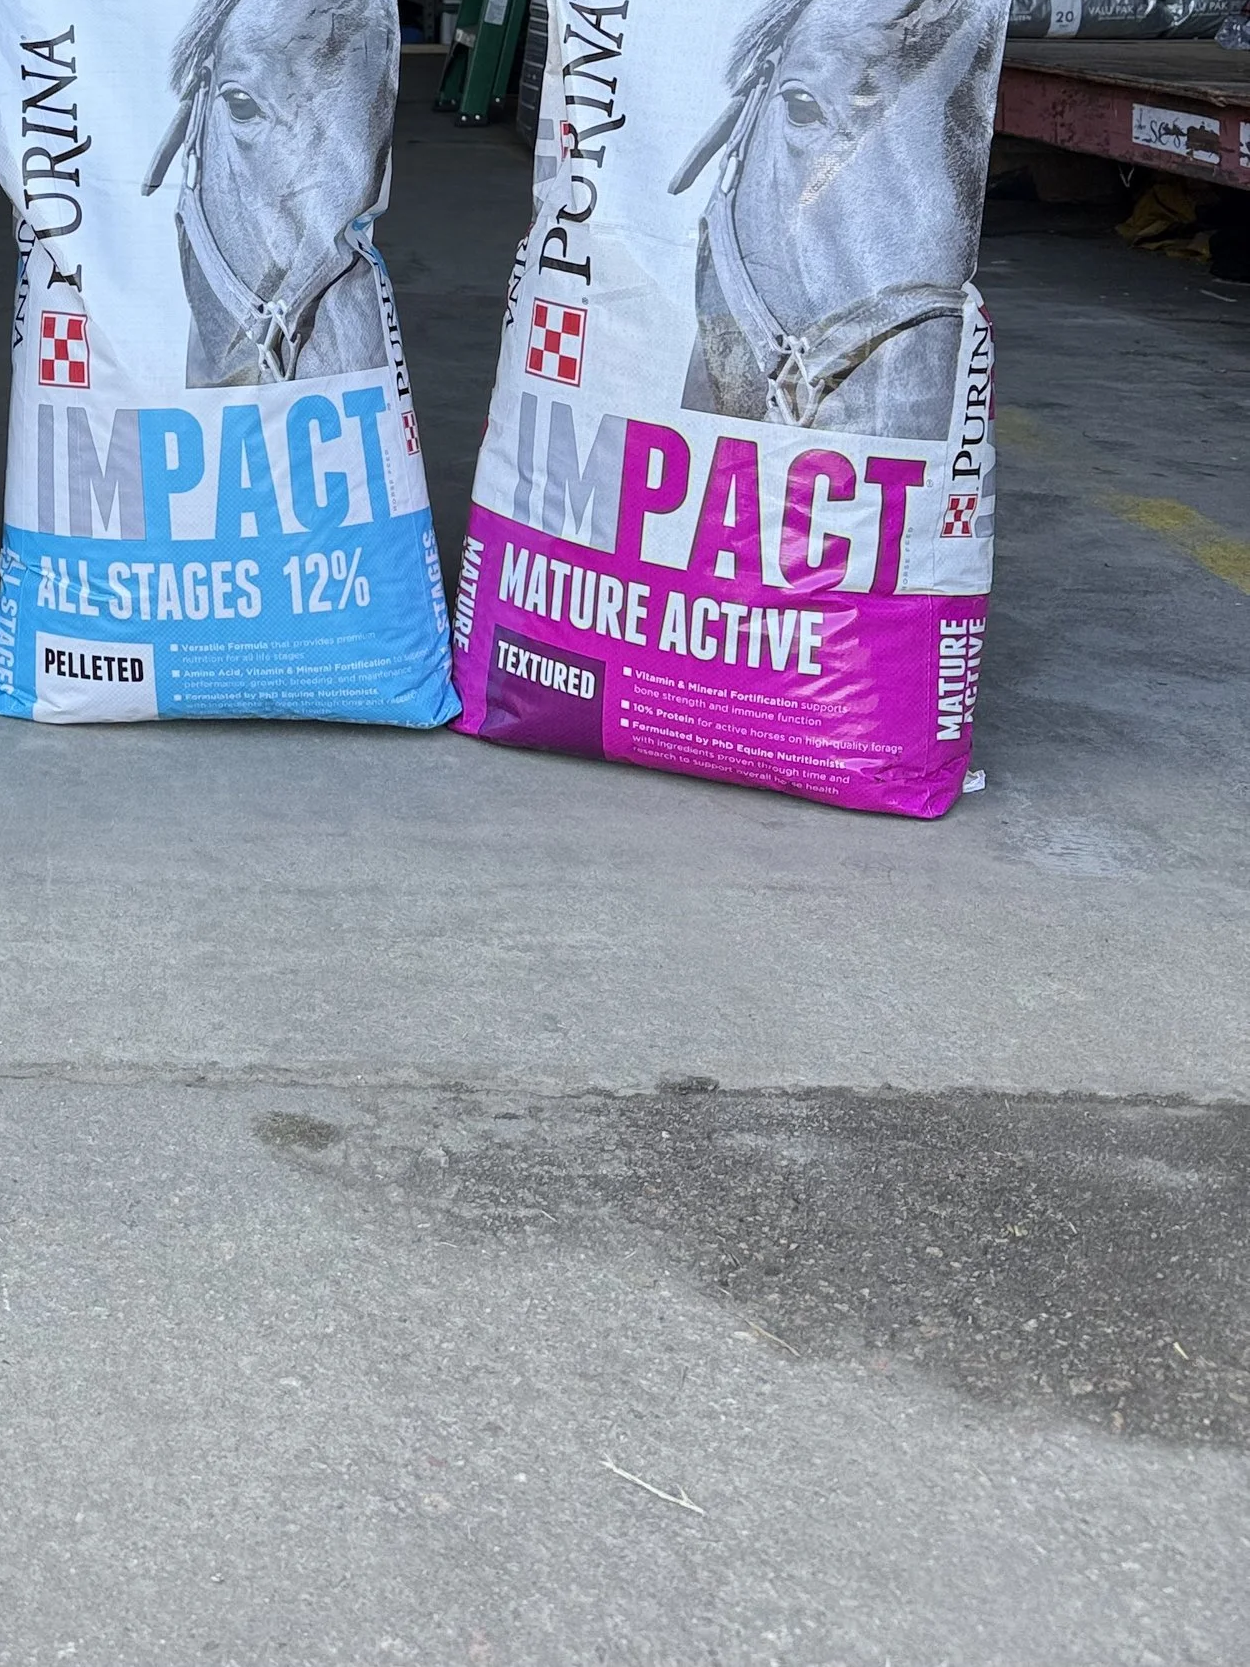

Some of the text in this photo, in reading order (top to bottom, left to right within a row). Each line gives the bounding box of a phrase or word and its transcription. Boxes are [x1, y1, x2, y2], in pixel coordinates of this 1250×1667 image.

[1056, 11, 1075, 24] 20
[1089, 3, 1135, 15] VALU PAK
[37, 386, 391, 541] IMPACT
[513, 391, 927, 595] IMPACT
[37, 546, 371, 621] ALL STAGES 12%
[422, 529, 450, 635] STAGES
[454, 535, 485, 652] MATURE
[498, 541, 824, 677] MATURE ACTIVE
[44, 647, 144, 683] PELLETED
[495, 638, 596, 700] TEXTURED
[634, 669, 849, 715] Vitamin & Mineral Fortification supports
[937, 618, 968, 742] MATURE
[632, 702, 904, 755] 10% Protein for active horses on high-quality forage
[633, 684, 822, 728] bone strength and immune function
[632, 720, 846, 770] Formulated by PhD Equine Nutritionists
[632, 734, 850, 784] with ingredients proven through time and
